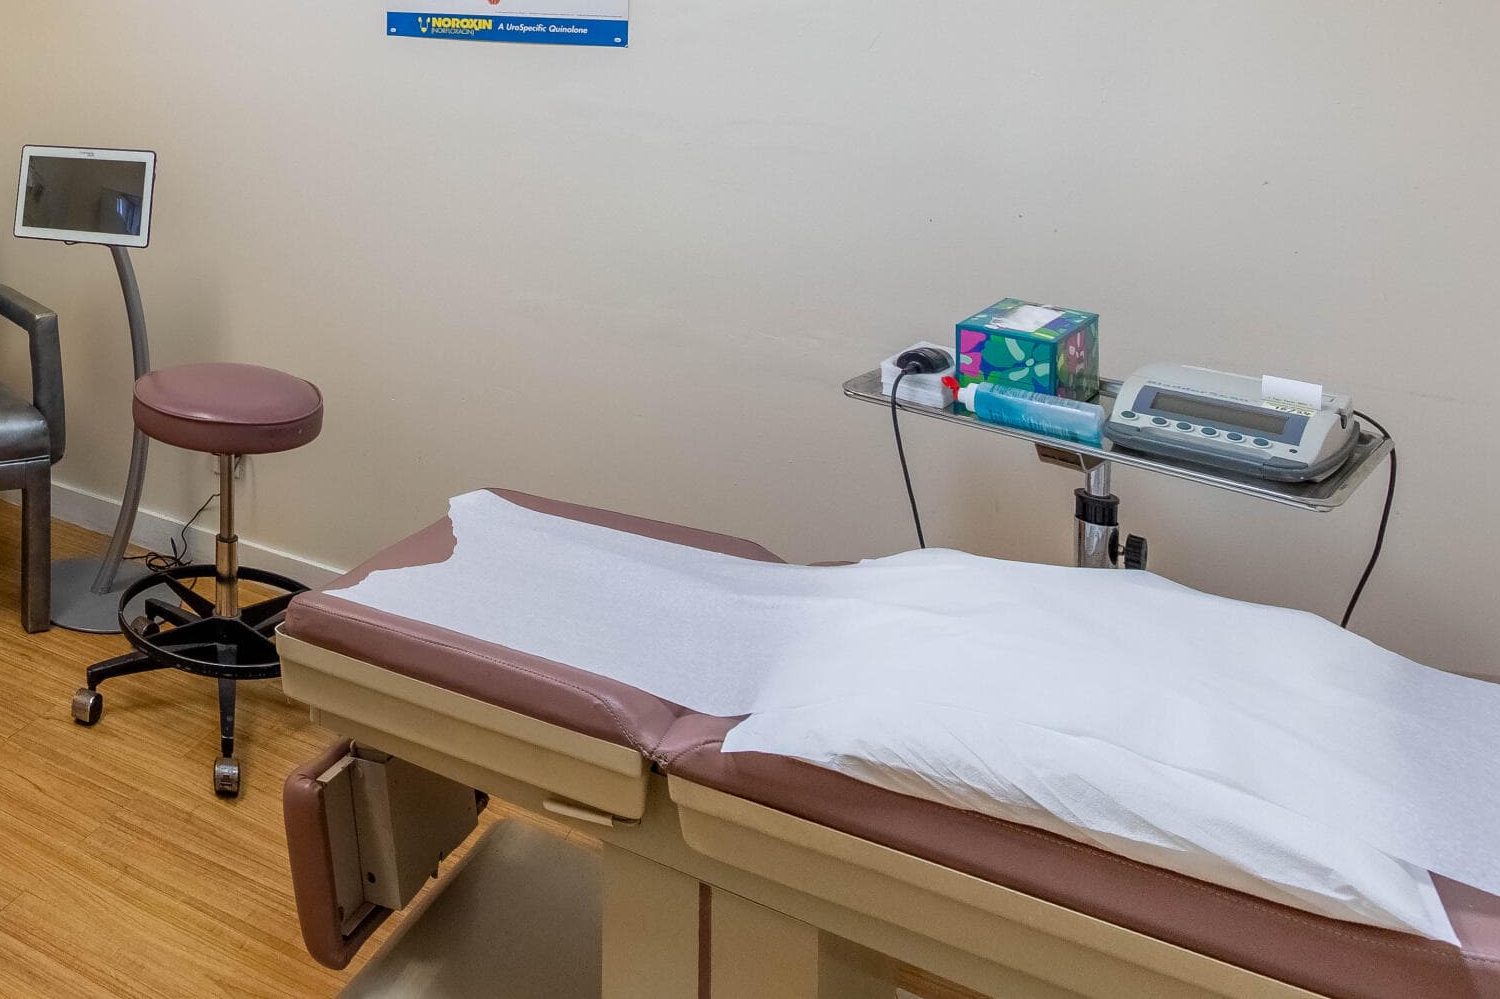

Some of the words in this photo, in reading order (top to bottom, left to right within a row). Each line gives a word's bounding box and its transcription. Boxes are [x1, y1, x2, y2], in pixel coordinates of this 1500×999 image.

[431, 17, 493, 31] NOROXIN
[497, 22, 505, 31] A
[506, 23, 547, 33] UroSpecific
[548, 24, 589, 35] Quinolone
